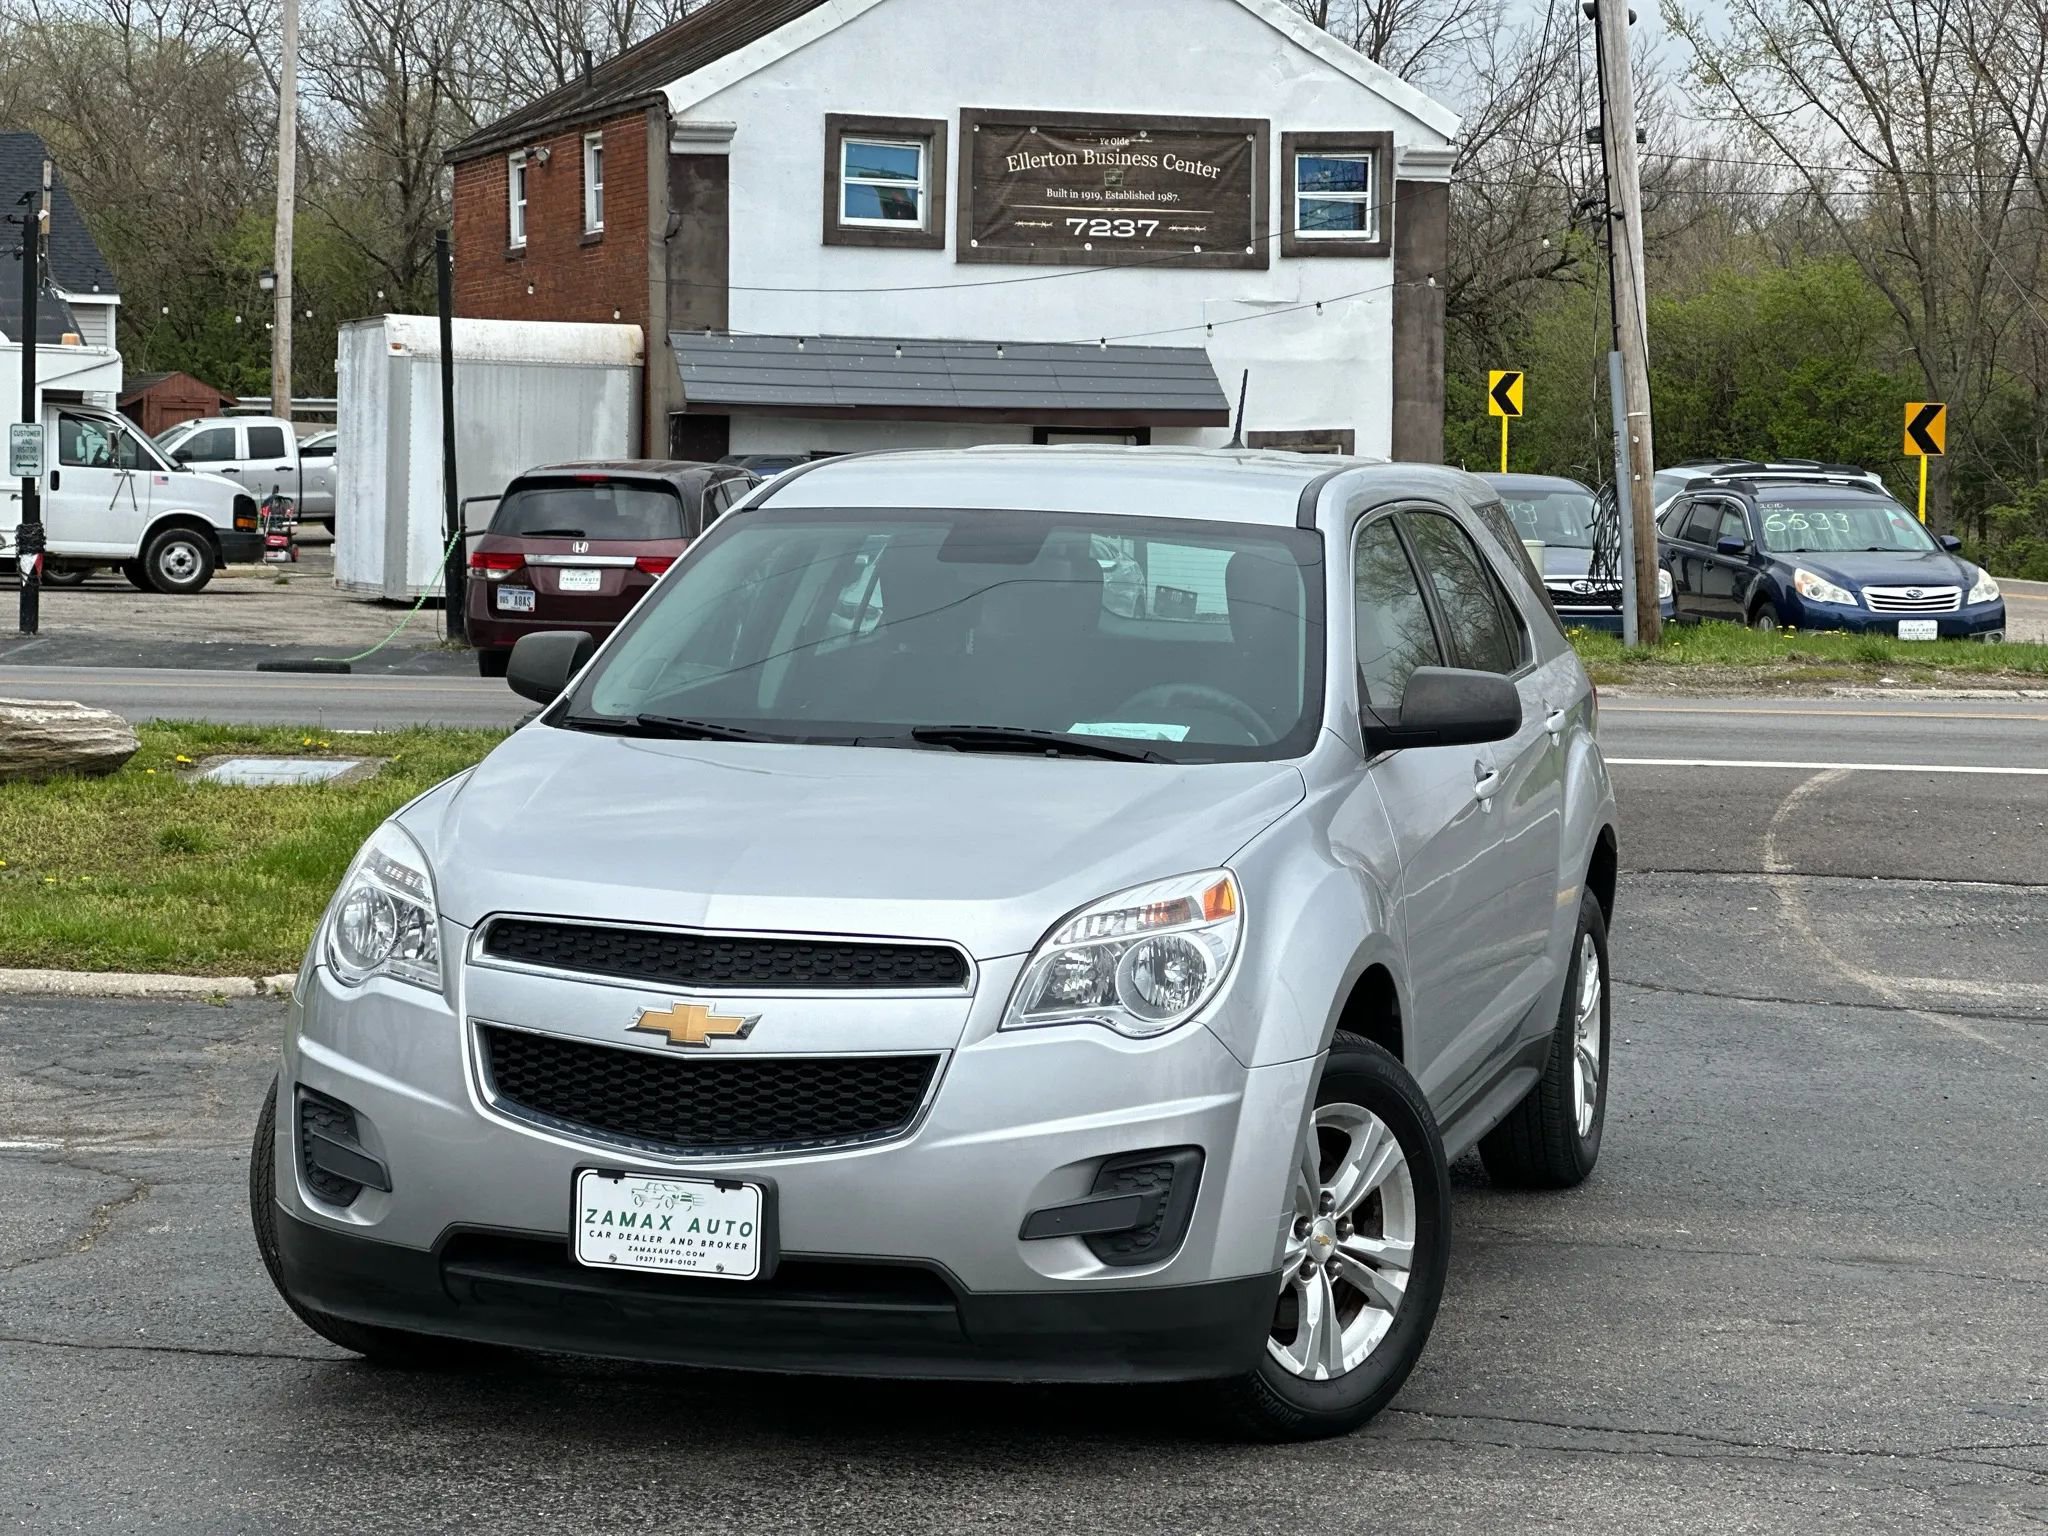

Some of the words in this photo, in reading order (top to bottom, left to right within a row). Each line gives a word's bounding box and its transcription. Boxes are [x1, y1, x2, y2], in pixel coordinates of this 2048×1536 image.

[1100, 138, 1109, 146] Ye
[1110, 137, 1130, 146] Olde
[1006, 151, 1078, 172] Ellerton
[1082, 148, 1158, 167] Business
[1163, 153, 1221, 179] Center
[1046, 188, 1067, 198] Built
[1069, 189, 1079, 199] in
[1081, 191, 1102, 201] 1919,
[1105, 190, 1155, 201] Established
[1157, 191, 1180, 202] 1987.
[1066, 217, 1160, 238] 7237
[21, 438, 33, 446] AND
[15, 454, 39, 462] PARKING
[1765, 512, 1850, 532] 6599
[585, 1208, 673, 1231] ZAMAX
[687, 1217, 753, 1238] AUTO
[589, 1230, 612, 1239] CAR
[619, 1232, 663, 1244] DEALER
[670, 1237, 694, 1246] AND
[701, 1240, 748, 1250] BROKER
[628, 1245, 706, 1258] ZAMAXAUTO.COM
[635, 1255, 656, 1264] (937)
[659, 1257, 697, 1266] 934-0102
